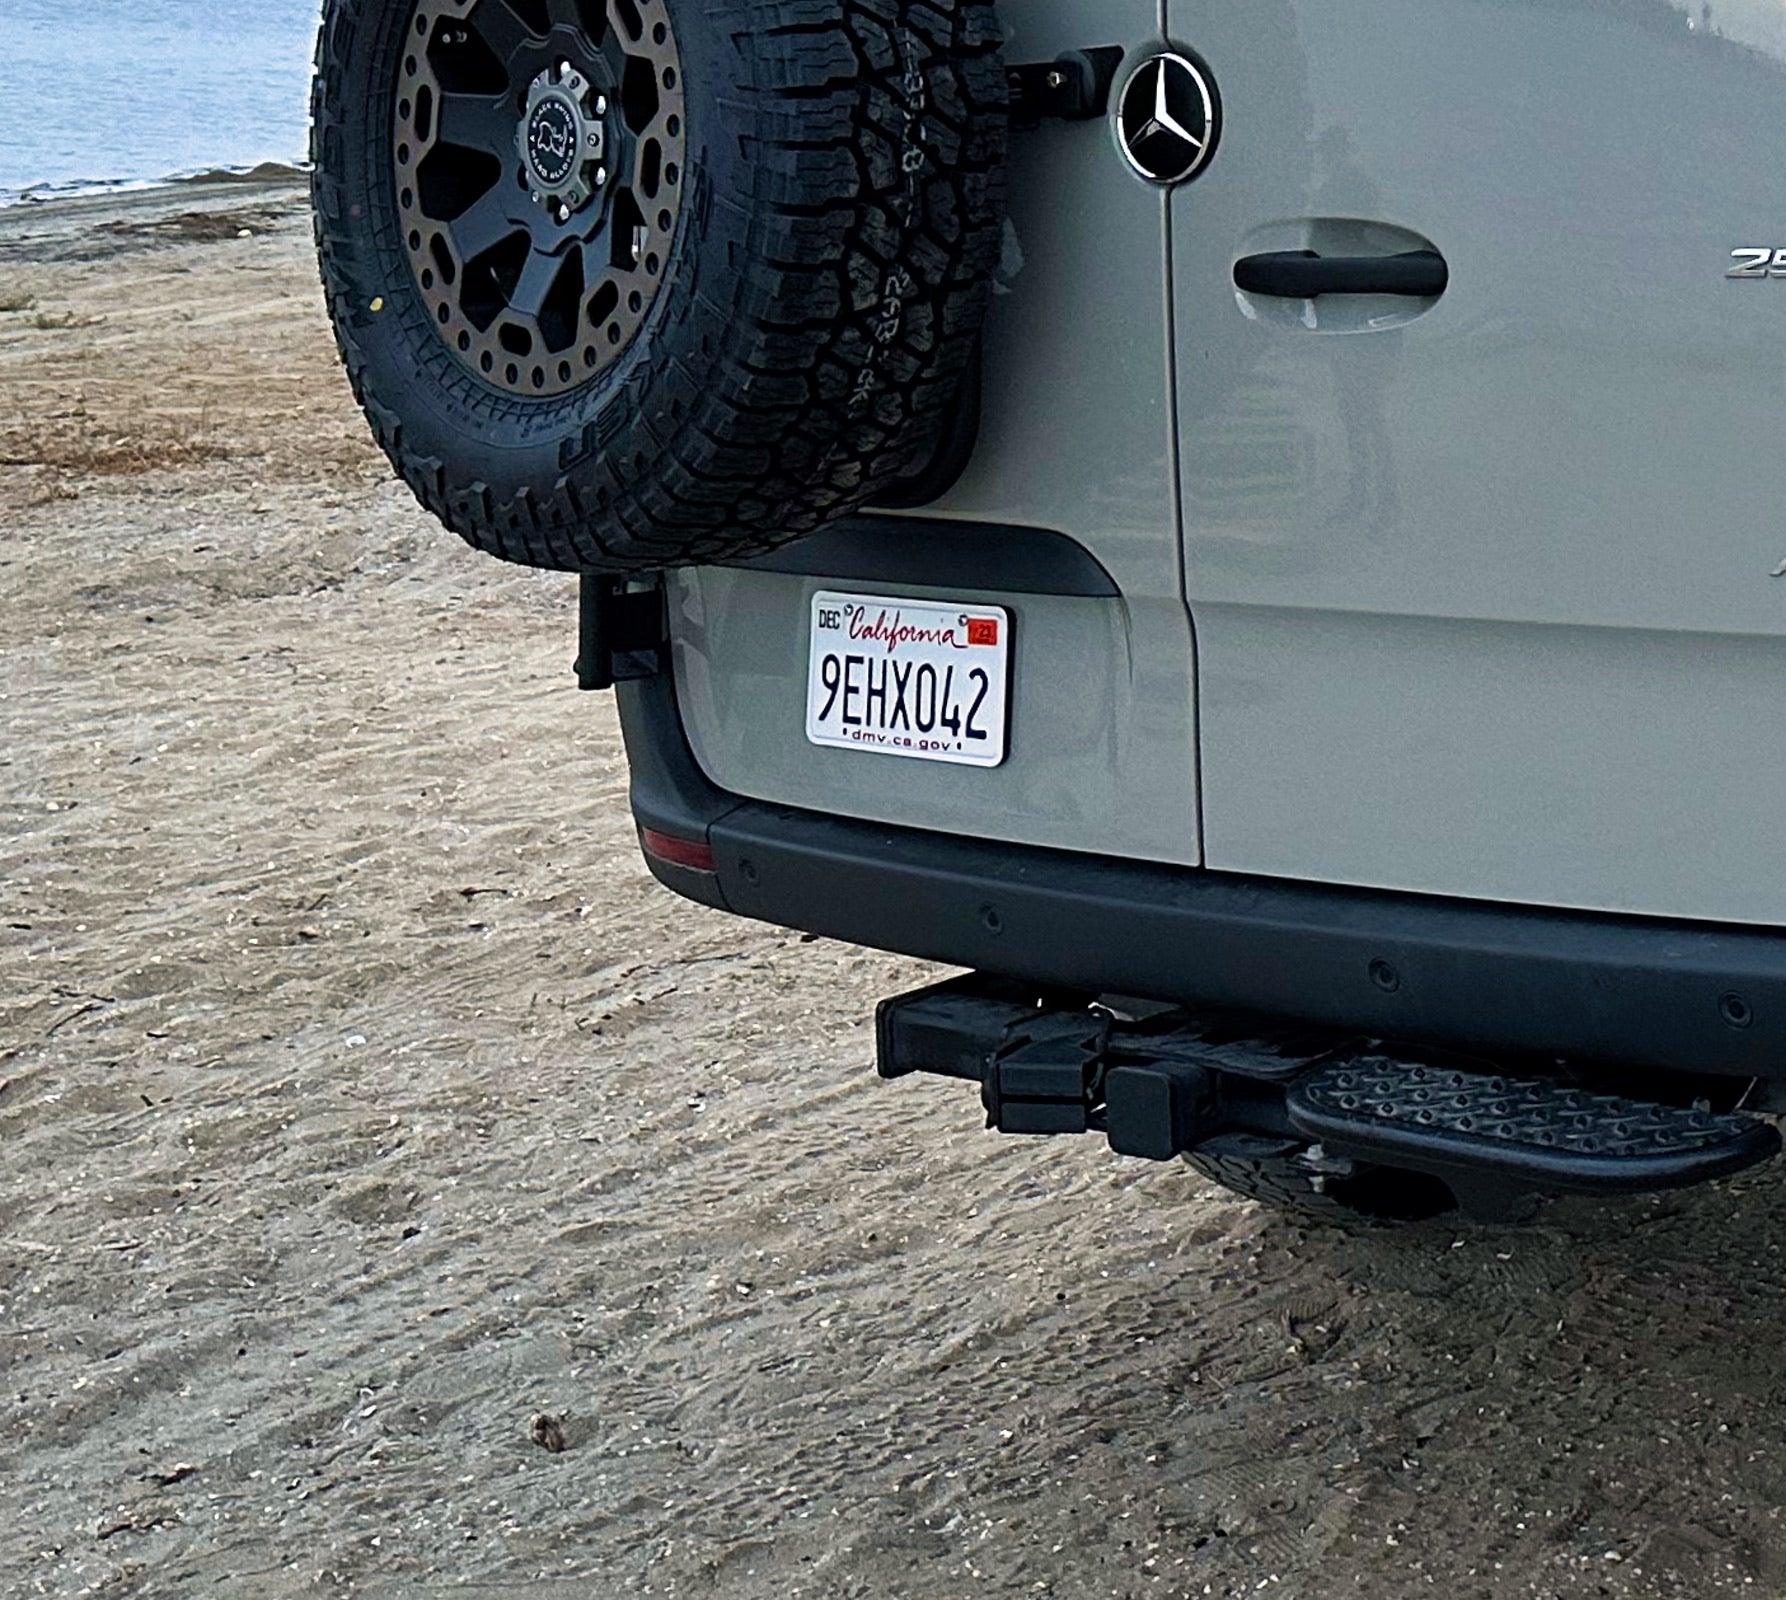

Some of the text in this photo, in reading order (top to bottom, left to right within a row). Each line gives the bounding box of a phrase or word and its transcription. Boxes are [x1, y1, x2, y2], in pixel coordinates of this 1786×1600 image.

[818, 609, 841, 630] DEC
[849, 605, 968, 653] California
[818, 653, 989, 740] 9EHX042
[852, 729, 951, 751] dmv.ca.gov
